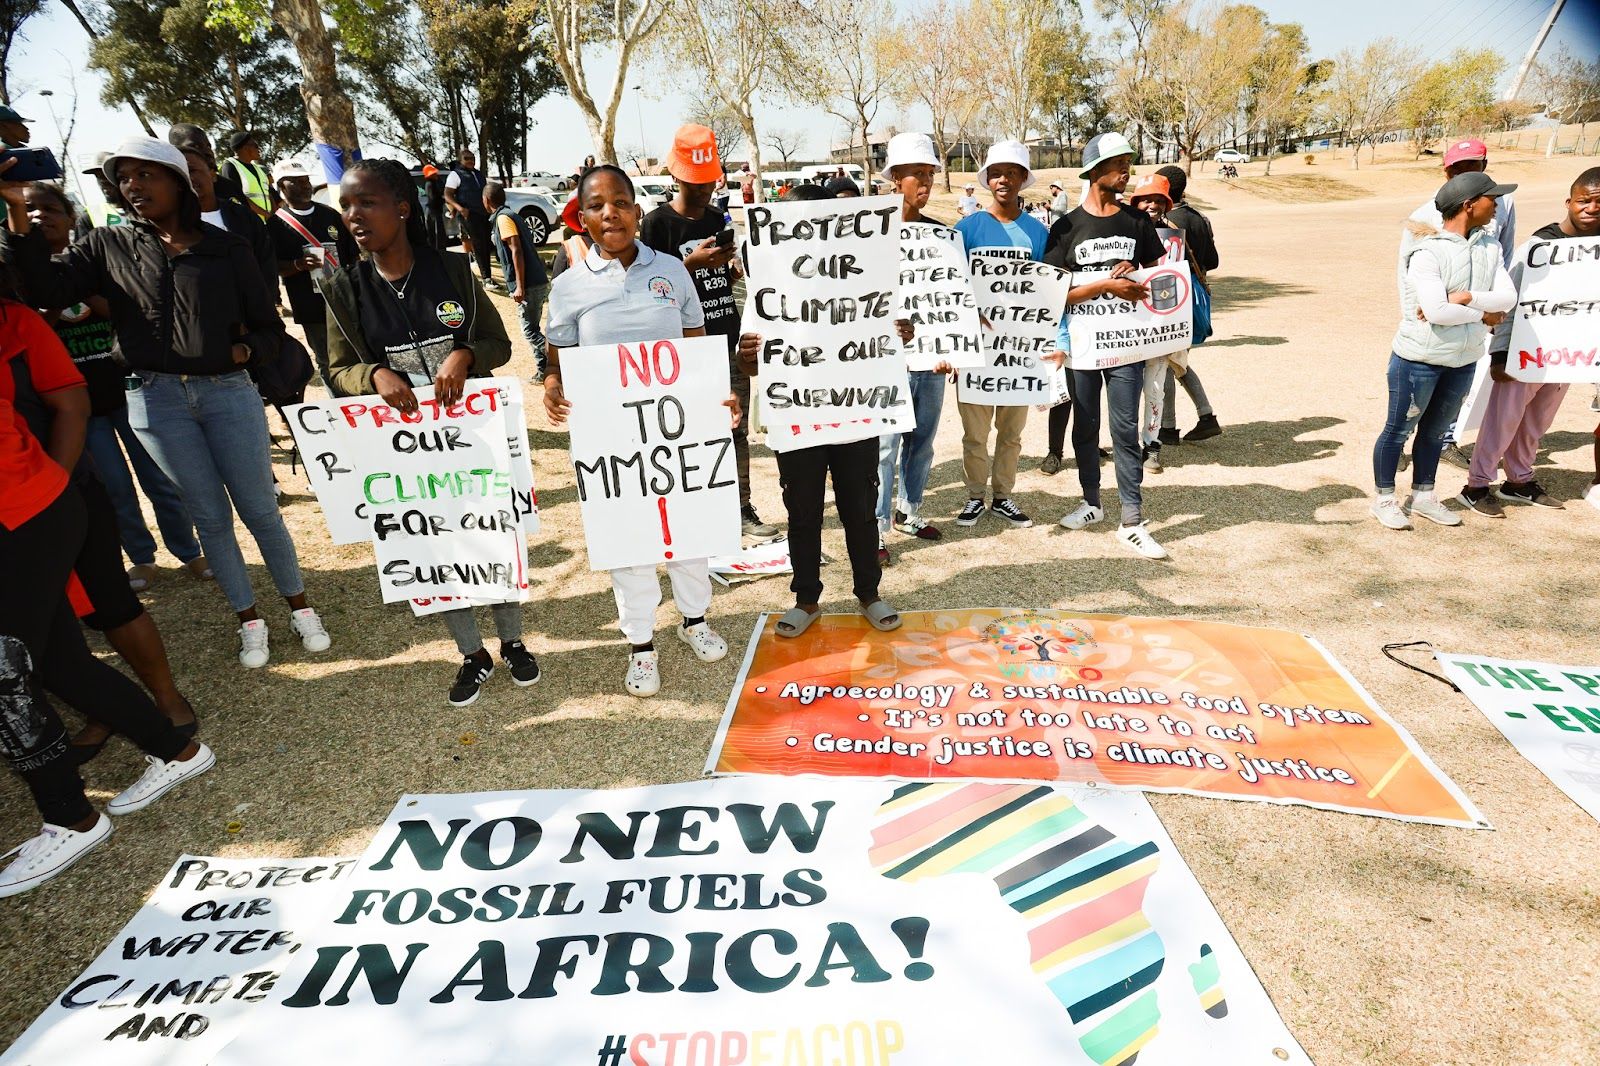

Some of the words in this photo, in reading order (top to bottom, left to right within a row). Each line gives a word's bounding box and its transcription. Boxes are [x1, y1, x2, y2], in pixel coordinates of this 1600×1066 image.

[692, 149, 713, 165] UJ
[748, 206, 898, 246] PROTECT
[900, 225, 958, 241] OTECT
[695, 267, 710, 279] FIX
[792, 253, 864, 279] OUR
[900, 267, 968, 285] ATER,
[971, 258, 1069, 281] PROTECT
[703, 276, 727, 291] R350
[990, 280, 1035, 295] OUR
[706, 309, 724, 320] MUST
[755, 288, 893, 325] CLIMATE
[900, 291, 975, 310] IMATE
[910, 311, 959, 325] AND
[1095, 321, 1189, 341] RENEWABLE
[763, 339, 826, 367] FOR
[838, 335, 897, 362] OUR
[982, 333, 1056, 353] LIMATE
[1096, 337, 1141, 350] ENERGY
[1143, 331, 1190, 346] BUILDS!
[618, 340, 680, 388] NO
[994, 353, 1036, 369] AND
[340, 387, 502, 428] PROTECT
[766, 382, 907, 409] SURVIVAL
[622, 395, 685, 444] TO
[392, 426, 472, 453] OUR
[575, 437, 735, 501] MMSEZ
[364, 468, 511, 505] CLIMATE
[374, 509, 453, 541] FOR
[460, 510, 516, 533] OUR
[383, 560, 518, 589] SURVIVAL
[1451, 661, 1564, 692] THE
[780, 682, 954, 708] Agroecology
[968, 682, 991, 699] &
[1003, 682, 1171, 706] sustainable
[1179, 692, 1250, 716] food
[1257, 701, 1372, 728] system
[884, 708, 943, 728] It's
[956, 709, 1007, 728] not
[1020, 709, 1071, 728] too
[1081, 710, 1149, 733] late
[1157, 714, 1194, 737] to
[1206, 722, 1257, 744] act
[813, 733, 926, 758] Gender
[934, 736, 1052, 766] justice
[1063, 737, 1093, 760] is
[1106, 742, 1228, 771] climate
[1234, 751, 1357, 785] justice
[369, 815, 543, 871] NO
[559, 801, 836, 864] NEW
[169, 859, 357, 891] PROTECT
[181, 897, 272, 921] OUR
[333, 881, 584, 926] FOSSIL
[598, 868, 829, 914] FUELS
[122, 929, 303, 960] WATER,
[281, 942, 428, 1008] IN
[429, 916, 931, 1004] AFRICA!
[60, 970, 282, 1010] CLIMATE
[104, 1012, 211, 1041] AND
[597, 1020, 904, 1066] #STOPEACOP
